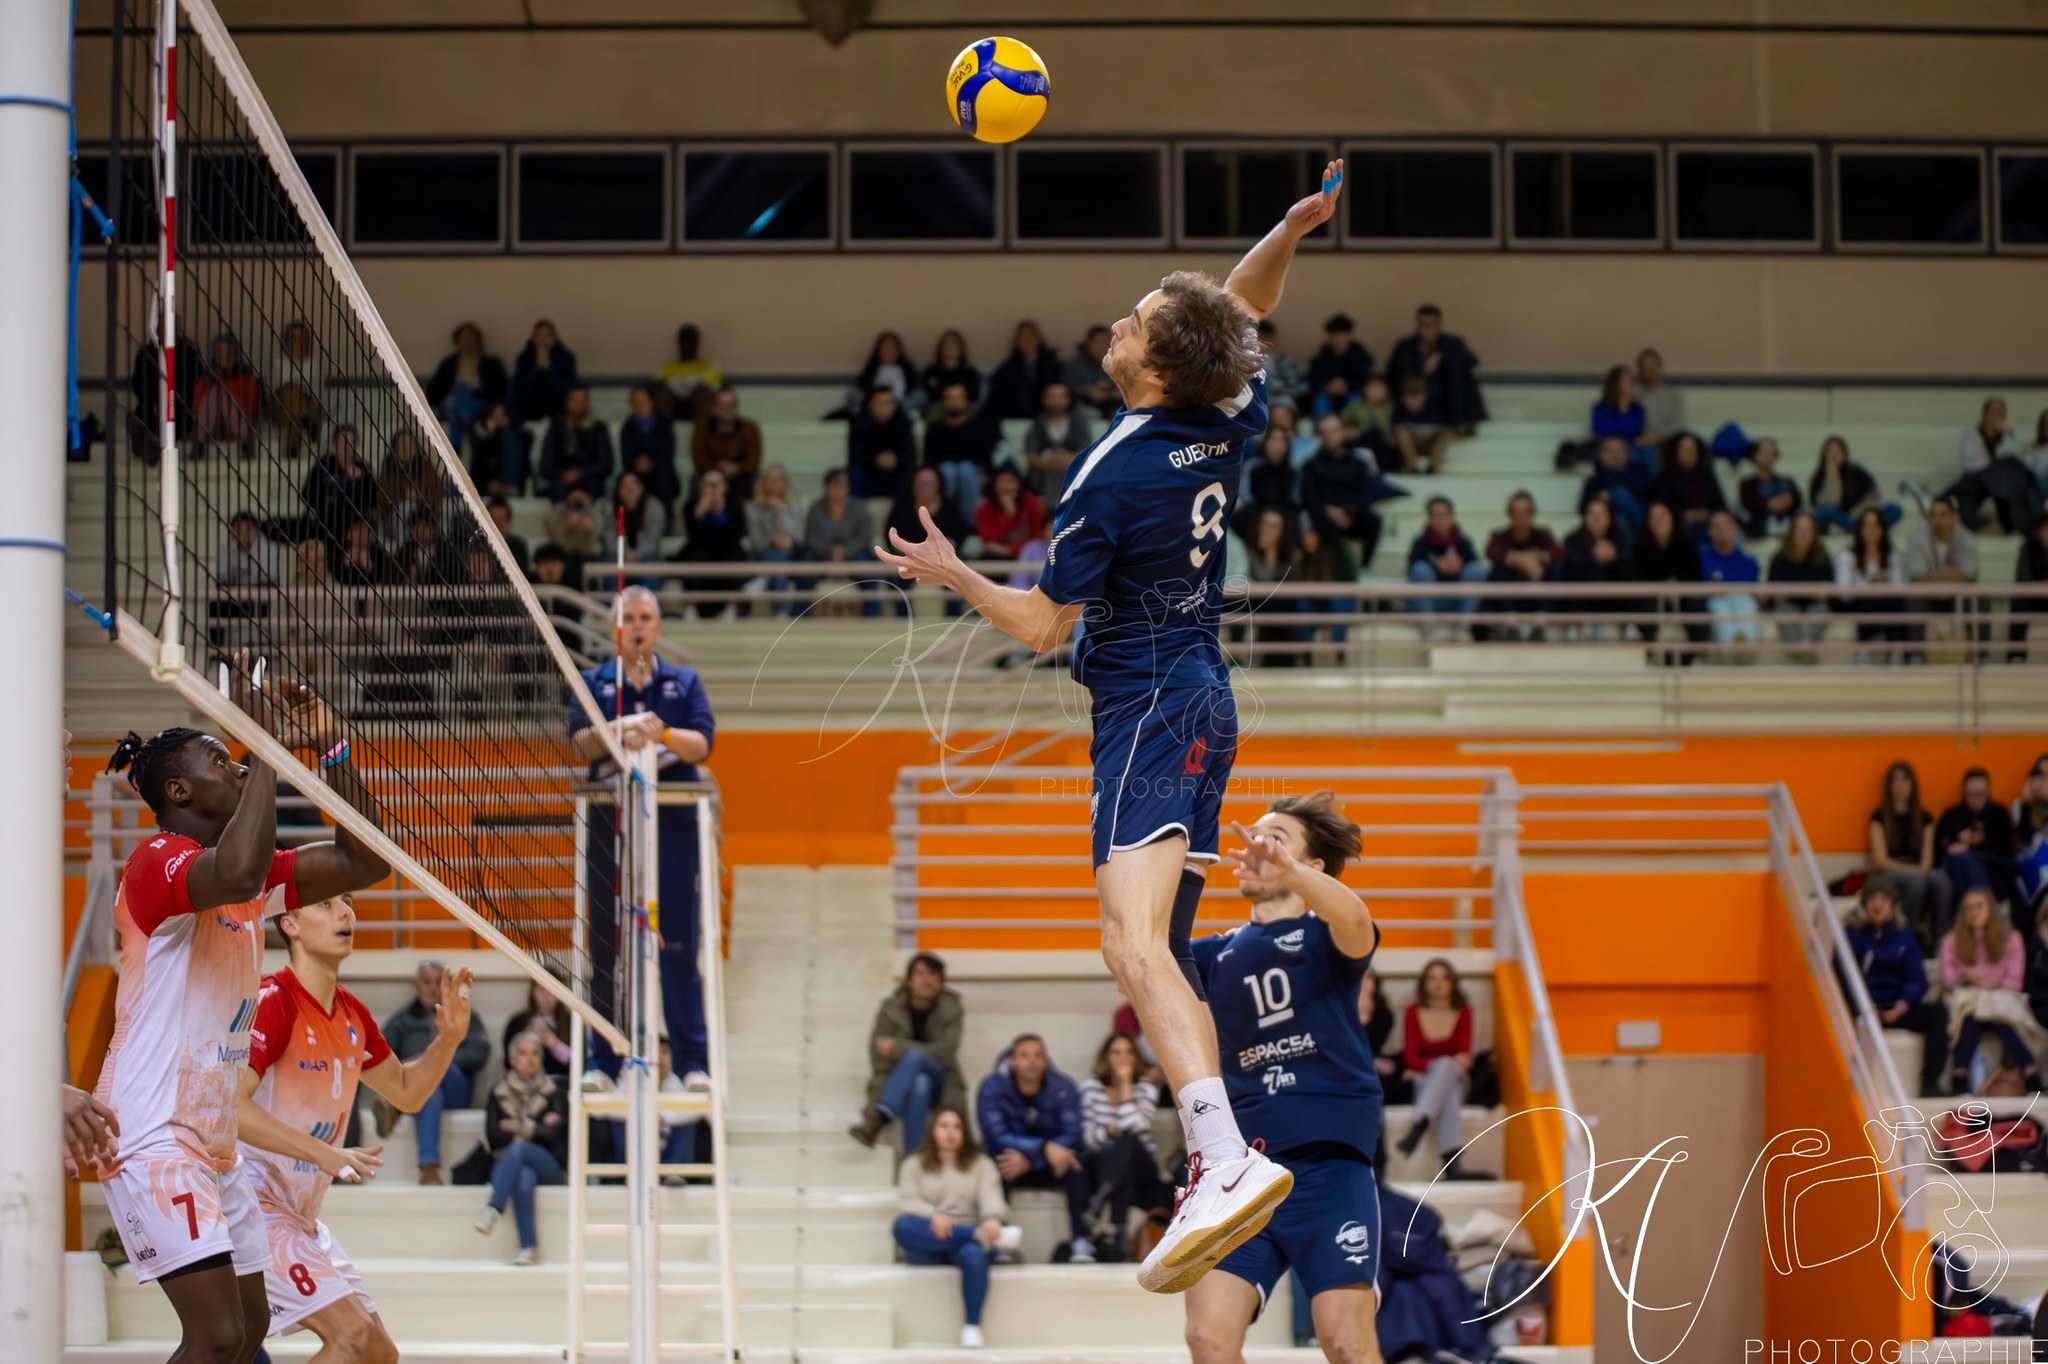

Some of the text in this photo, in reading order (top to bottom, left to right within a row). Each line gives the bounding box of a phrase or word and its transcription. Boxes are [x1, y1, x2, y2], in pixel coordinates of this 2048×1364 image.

[1168, 440, 1231, 469] GUERTIN
[1190, 481, 1226, 568] 9
[1243, 967, 1291, 1016] 10
[331, 1057, 343, 1100] 8
[171, 1192, 200, 1241] 7
[288, 1262, 317, 1297] 8
